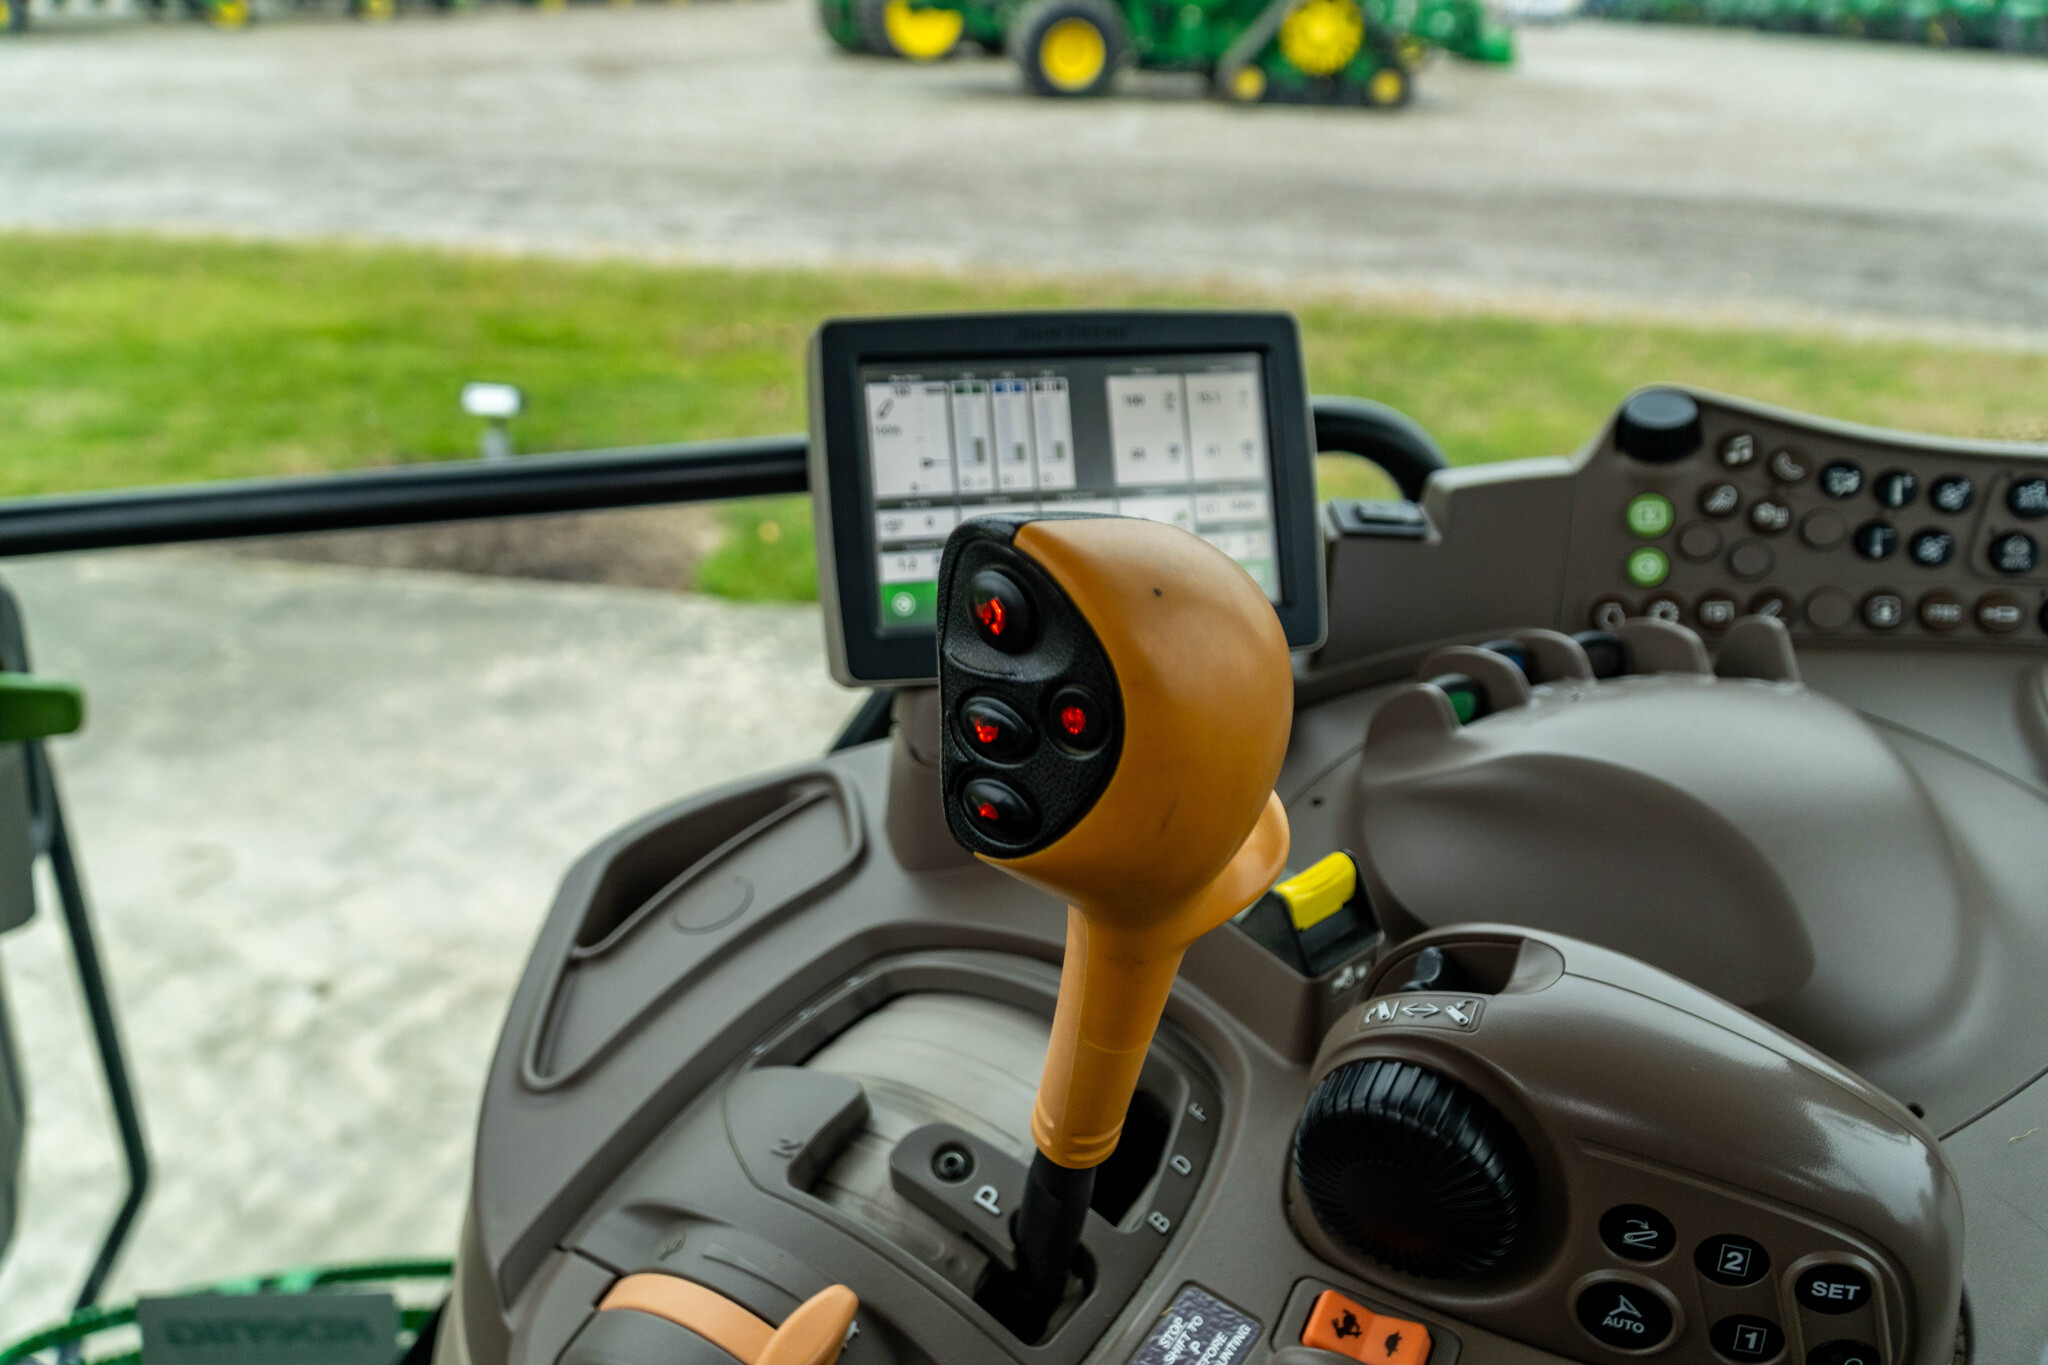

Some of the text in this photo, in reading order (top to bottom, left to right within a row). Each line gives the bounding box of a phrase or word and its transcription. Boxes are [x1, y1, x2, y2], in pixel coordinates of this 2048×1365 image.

[1187, 1101, 1207, 1123] F
[974, 1184, 1001, 1215] P
[1147, 1210, 1171, 1234] B
[1723, 1250, 1745, 1272] 2
[1810, 1280, 1861, 1301] SET
[1159, 1317, 1184, 1349] STOP
[1602, 1315, 1645, 1335] AUTO
[1163, 1315, 1204, 1365] SHIFT TO
[1188, 1340, 1201, 1356] P
[1744, 1331, 1758, 1350] 1
